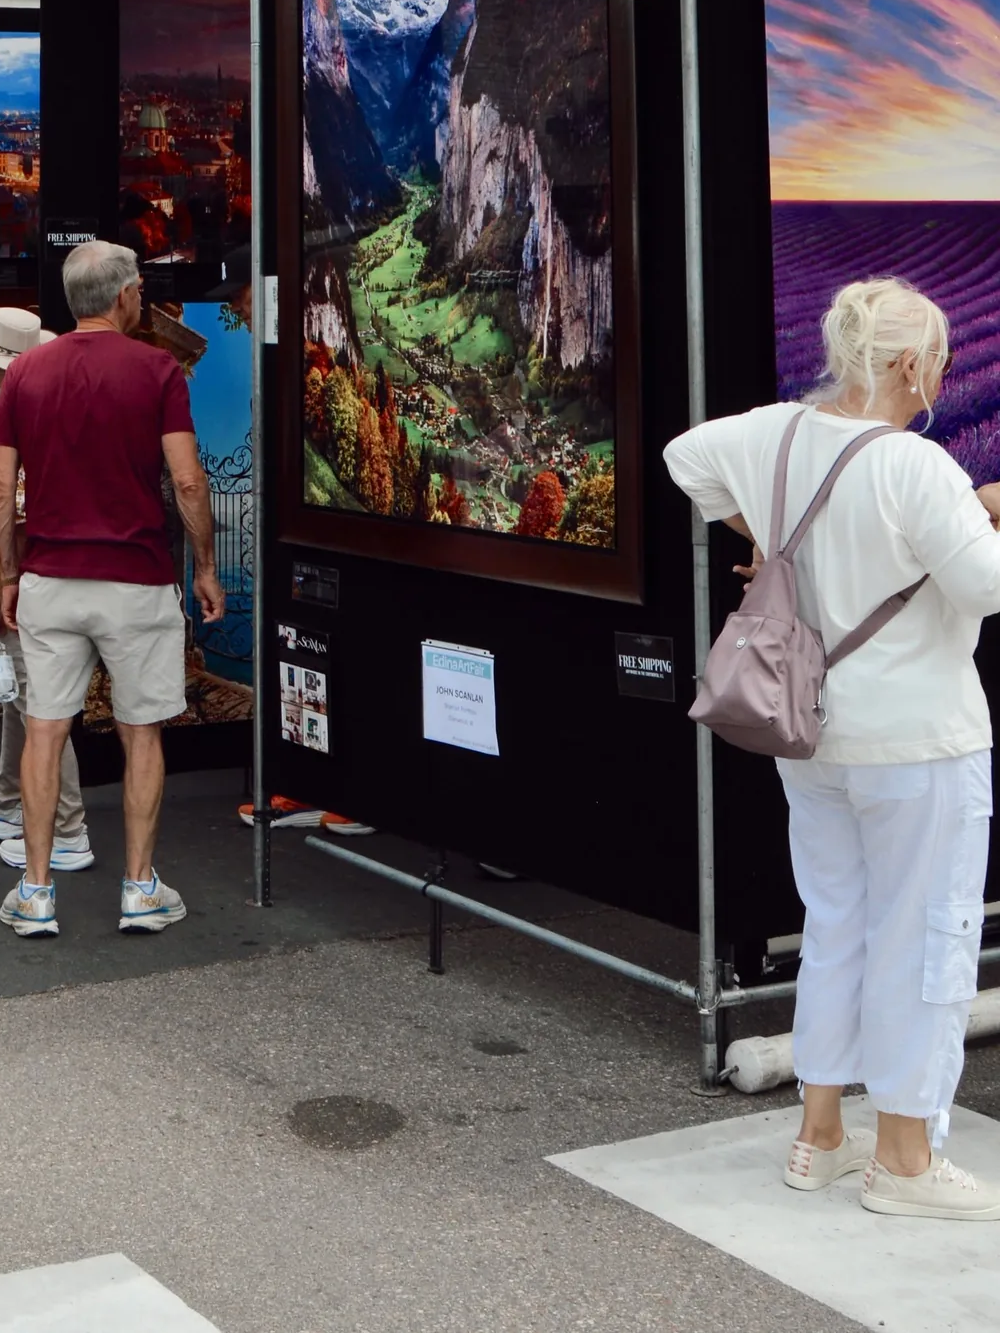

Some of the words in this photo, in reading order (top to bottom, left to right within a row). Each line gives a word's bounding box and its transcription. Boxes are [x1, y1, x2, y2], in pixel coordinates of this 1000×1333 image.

[47, 233, 65, 242] FREE
[65, 233, 96, 242] SHIPPING
[618, 654, 638, 669] FREE
[638, 656, 672, 674] SHIPPING
[436, 685, 454, 697] JOHN
[454, 689, 484, 704] SCANLAN
